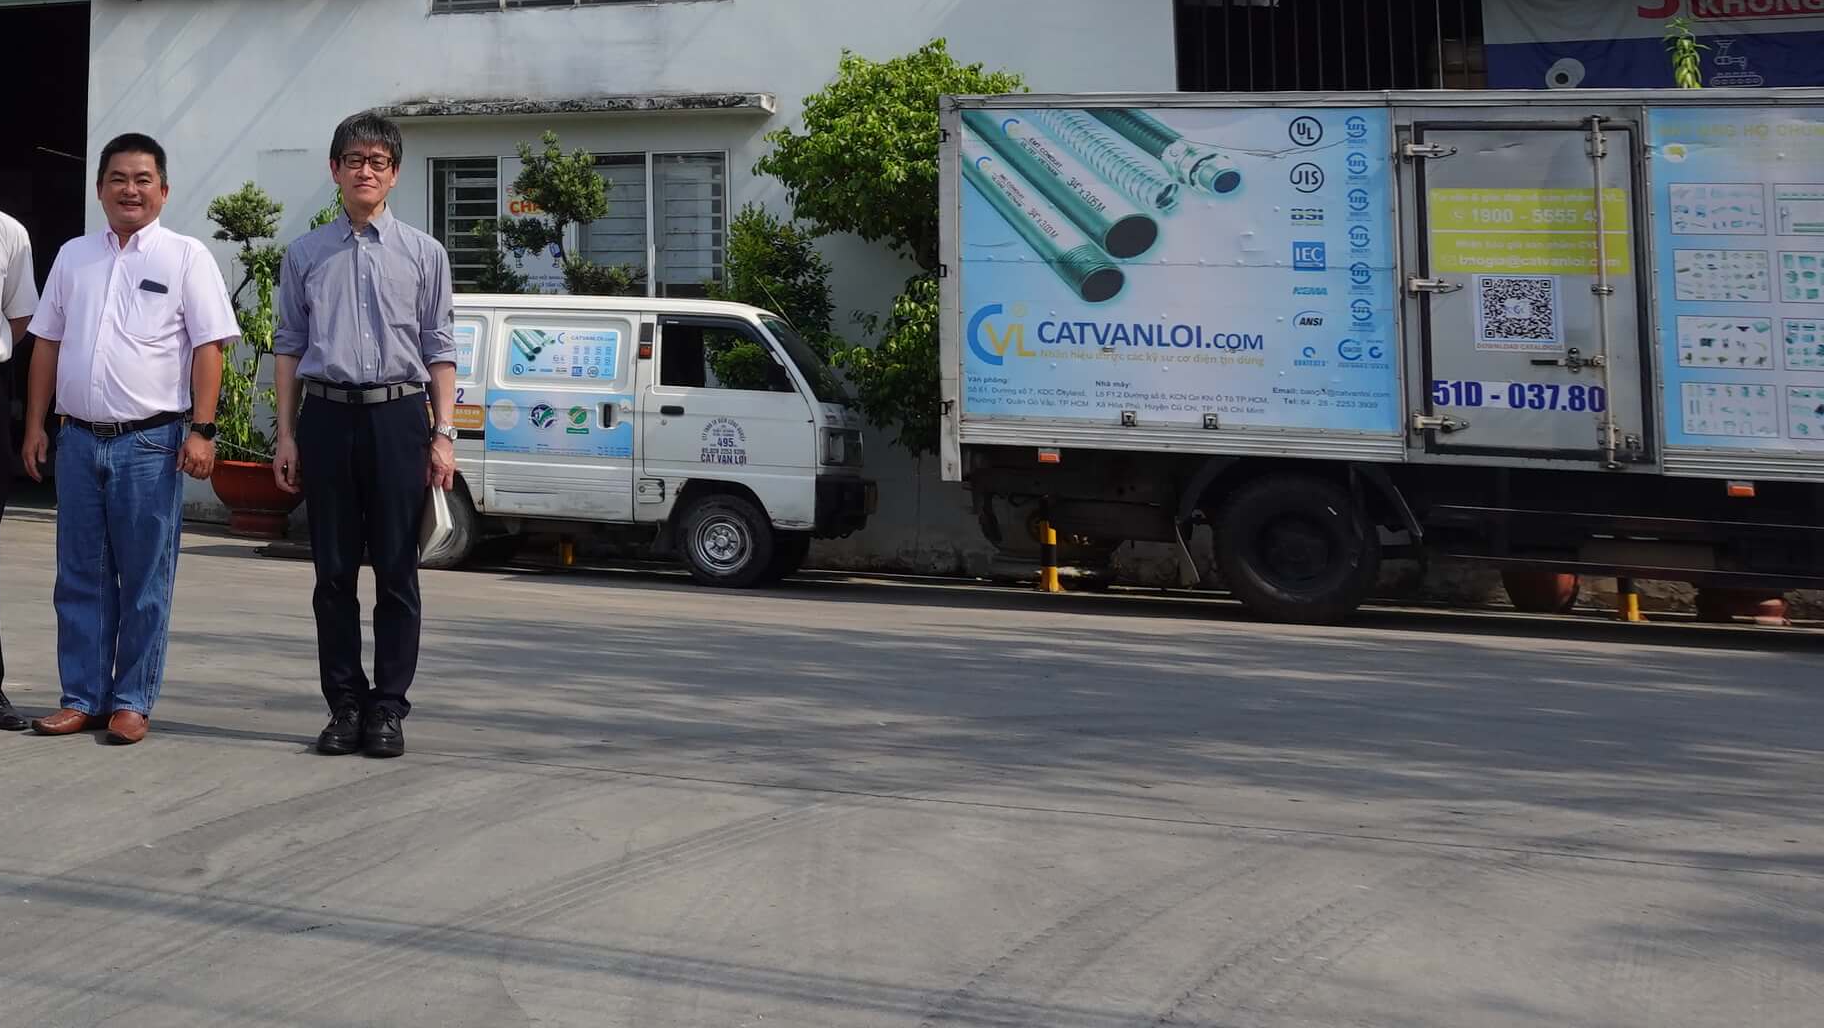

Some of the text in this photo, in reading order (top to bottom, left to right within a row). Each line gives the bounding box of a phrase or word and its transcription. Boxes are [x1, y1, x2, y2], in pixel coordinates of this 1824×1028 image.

[1296, 247, 1324, 262] IEC
[1299, 317, 1323, 326] ANSI
[1037, 320, 1263, 351] CATVANLOI.COM
[1432, 380, 1483, 406] 51D
[1508, 383, 1606, 413] 037.80
